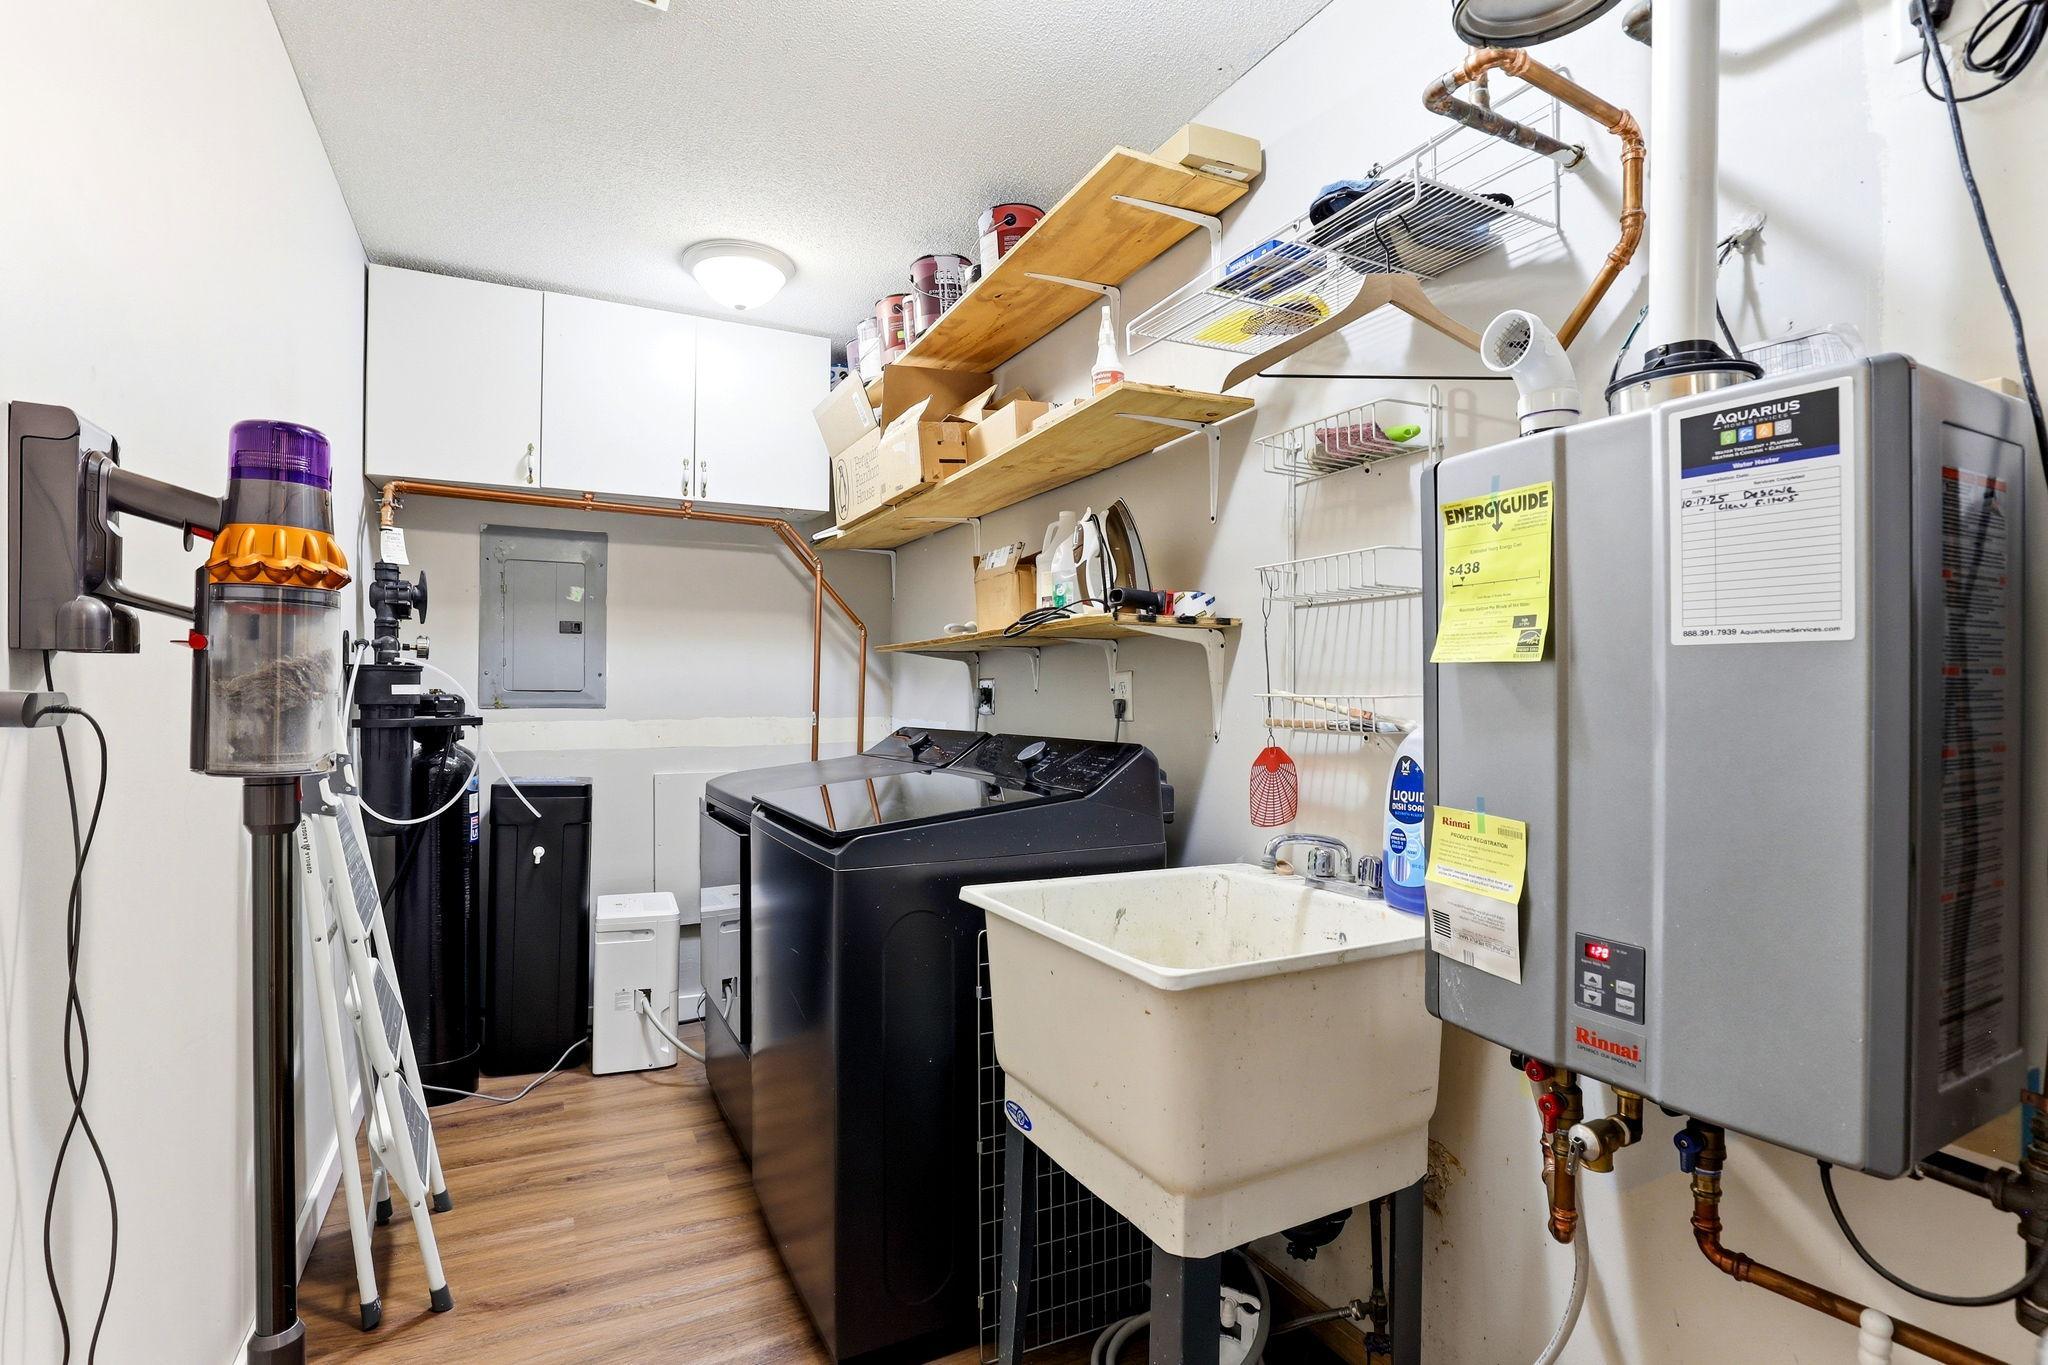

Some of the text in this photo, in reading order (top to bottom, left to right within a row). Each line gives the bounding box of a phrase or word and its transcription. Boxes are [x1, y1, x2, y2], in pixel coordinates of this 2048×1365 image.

[1713, 400, 1800, 426] AQUARIUS
[1724, 412, 1788, 429] HOME SERVICES
[1732, 456, 1780, 469] Water Heater
[856, 485, 875, 505] House
[1445, 490, 1549, 525] ENERGYGUIDE
[1449, 561, 1480, 576] $438
[1682, 625, 1841, 637] 888.391.7939 AquariusHomeServices.com
[1392, 802, 1407, 811] DISH
[1442, 816, 1470, 830] Rinnai
[1450, 831, 1508, 849] PRODUCT REGISTRATION
